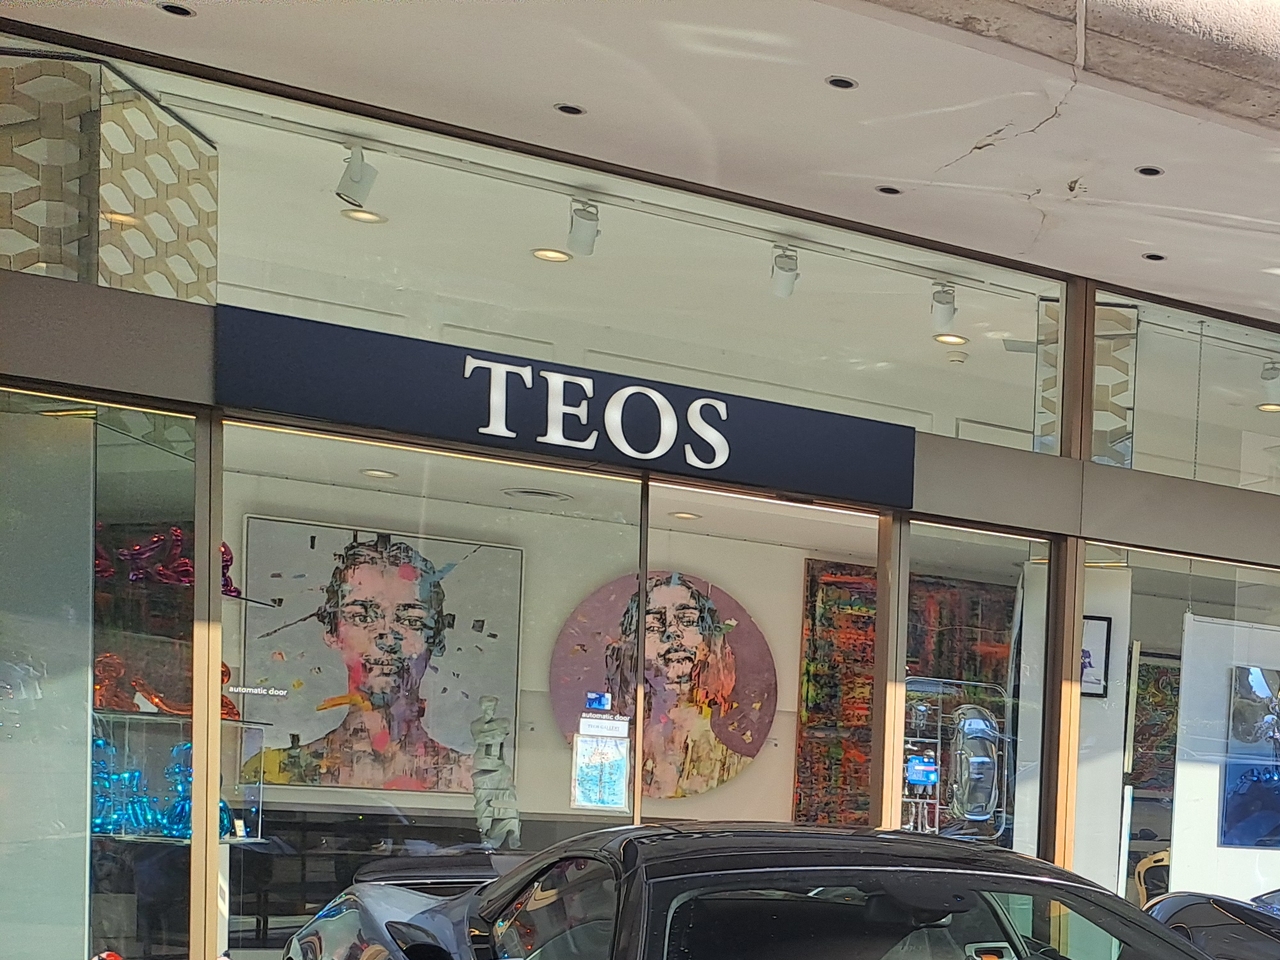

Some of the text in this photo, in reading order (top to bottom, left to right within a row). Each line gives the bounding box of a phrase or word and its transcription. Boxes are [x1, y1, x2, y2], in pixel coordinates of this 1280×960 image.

[464, 355, 730, 469] TEOS
[229, 686, 288, 696] automatic door
